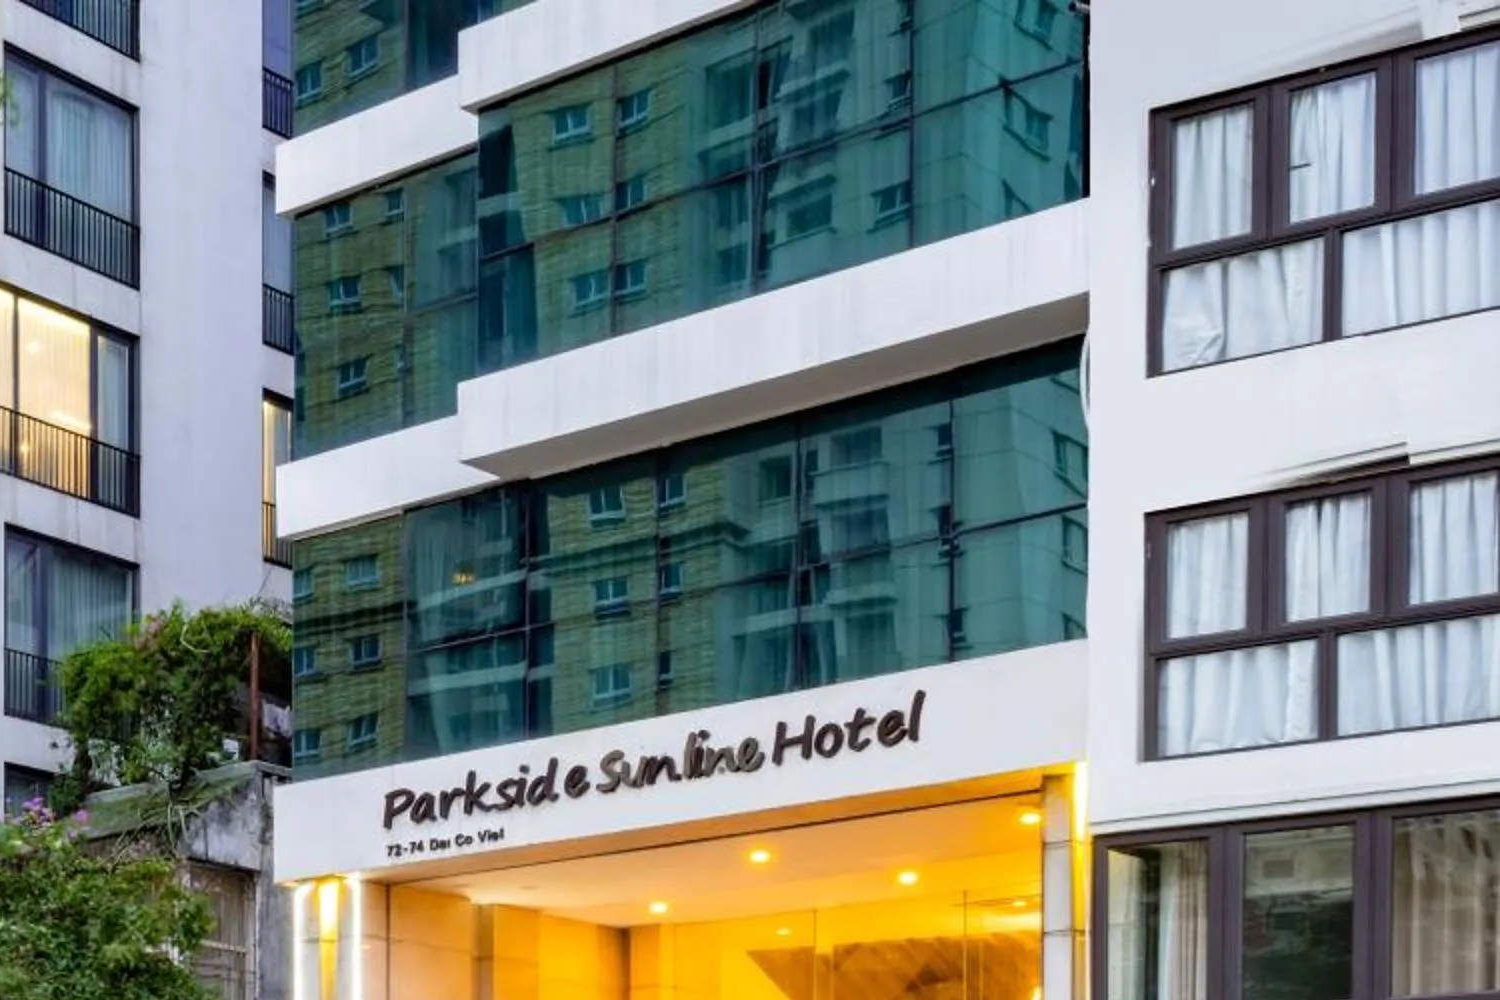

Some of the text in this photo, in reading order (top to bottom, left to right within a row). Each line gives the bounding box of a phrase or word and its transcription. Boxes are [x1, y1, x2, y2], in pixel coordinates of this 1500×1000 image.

[383, 689, 927, 830] Parkside Sunline Hotel
[386, 839, 425, 857] 72-74
[455, 833, 474, 847] Co
